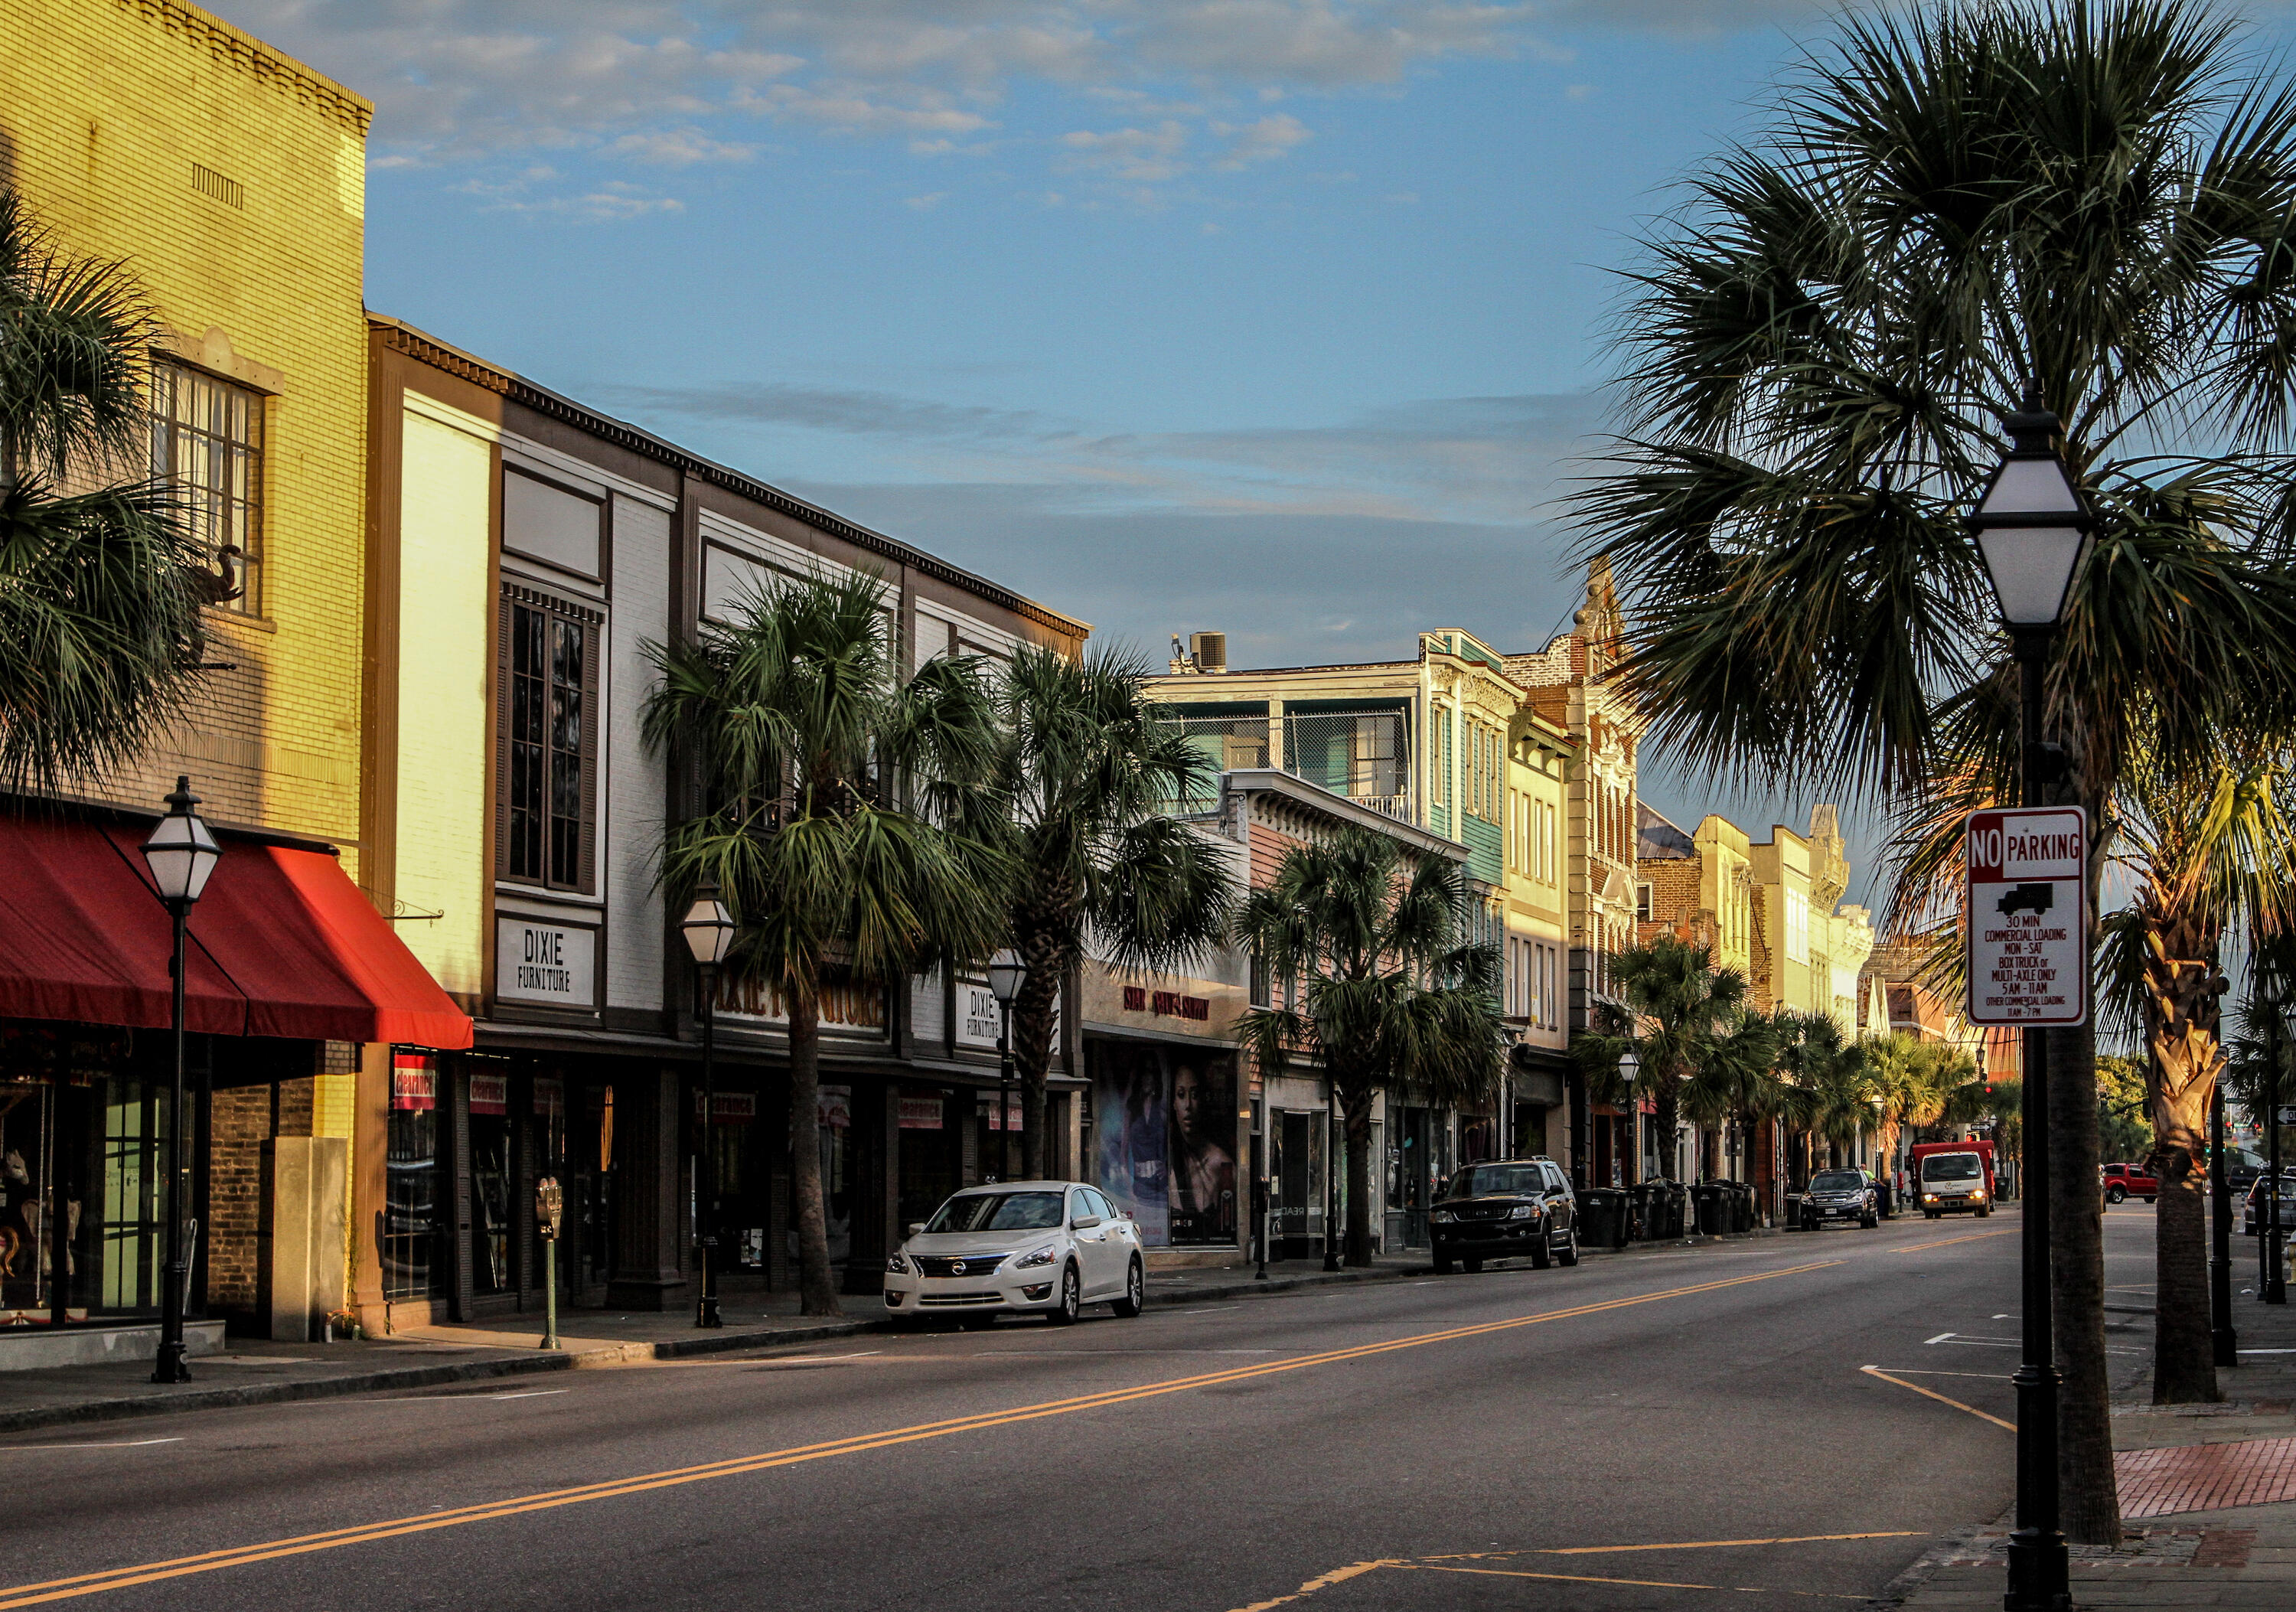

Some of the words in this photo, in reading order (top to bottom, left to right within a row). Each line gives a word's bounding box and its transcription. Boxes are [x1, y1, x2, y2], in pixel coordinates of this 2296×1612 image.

[1971, 829, 2001, 867] NO
[2007, 834, 2079, 861] PARKING
[2006, 916, 2020, 928] 30
[2022, 915, 2040, 927] MIN
[1985, 930, 2032, 942] COMMERCIAL
[2034, 928, 2066, 941] LOADING
[525, 928, 563, 966] DIXIE
[2004, 943, 2021, 954] MON
[2028, 942, 2043, 954] SAT
[1999, 958, 2014, 969] BOX
[2015, 957, 2039, 968] TRUCK
[2040, 959, 2049, 968] or
[517, 966, 569, 992] FURNITURE
[1991, 970, 2036, 981] MULTI-AXLE
[2037, 969, 2056, 981] ONLY
[971, 991, 994, 1019] DIXIE
[1986, 997, 2004, 1007] OTHER
[2005, 997, 2040, 1006] COMMERCIAL
[2041, 996, 2066, 1005] LOADING
[967, 1019, 998, 1039] FURNITURE
[396, 1071, 433, 1095] clearance
